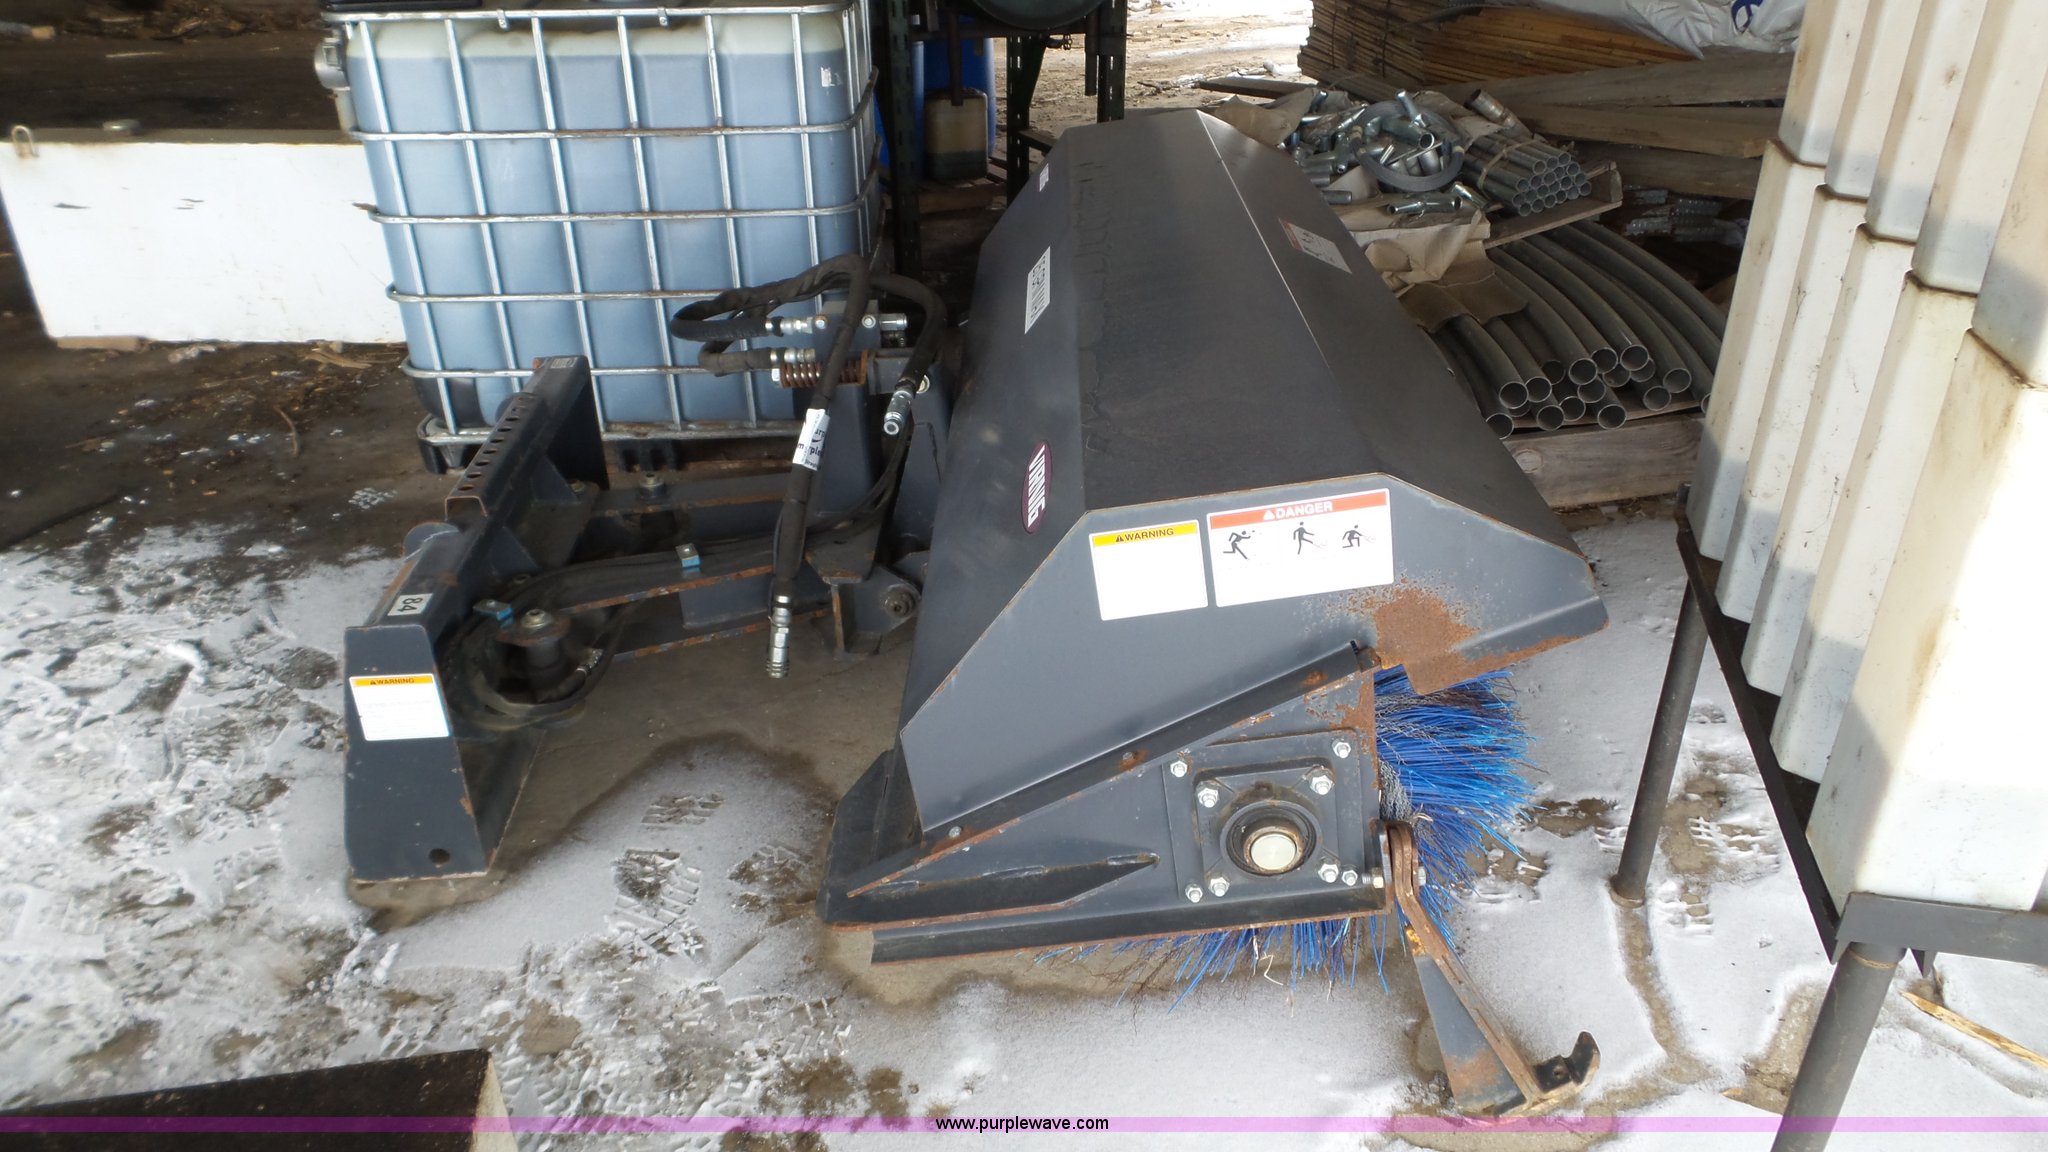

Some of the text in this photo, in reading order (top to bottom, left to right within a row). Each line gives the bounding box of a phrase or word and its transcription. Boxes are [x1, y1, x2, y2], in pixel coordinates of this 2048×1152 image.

[1027, 444, 1046, 528] VIRNIG
[1275, 501, 1333, 520] DANGER
[1124, 528, 1174, 541] WARNING
[398, 597, 423, 612] 84
[376, 677, 415, 685] WARNING
